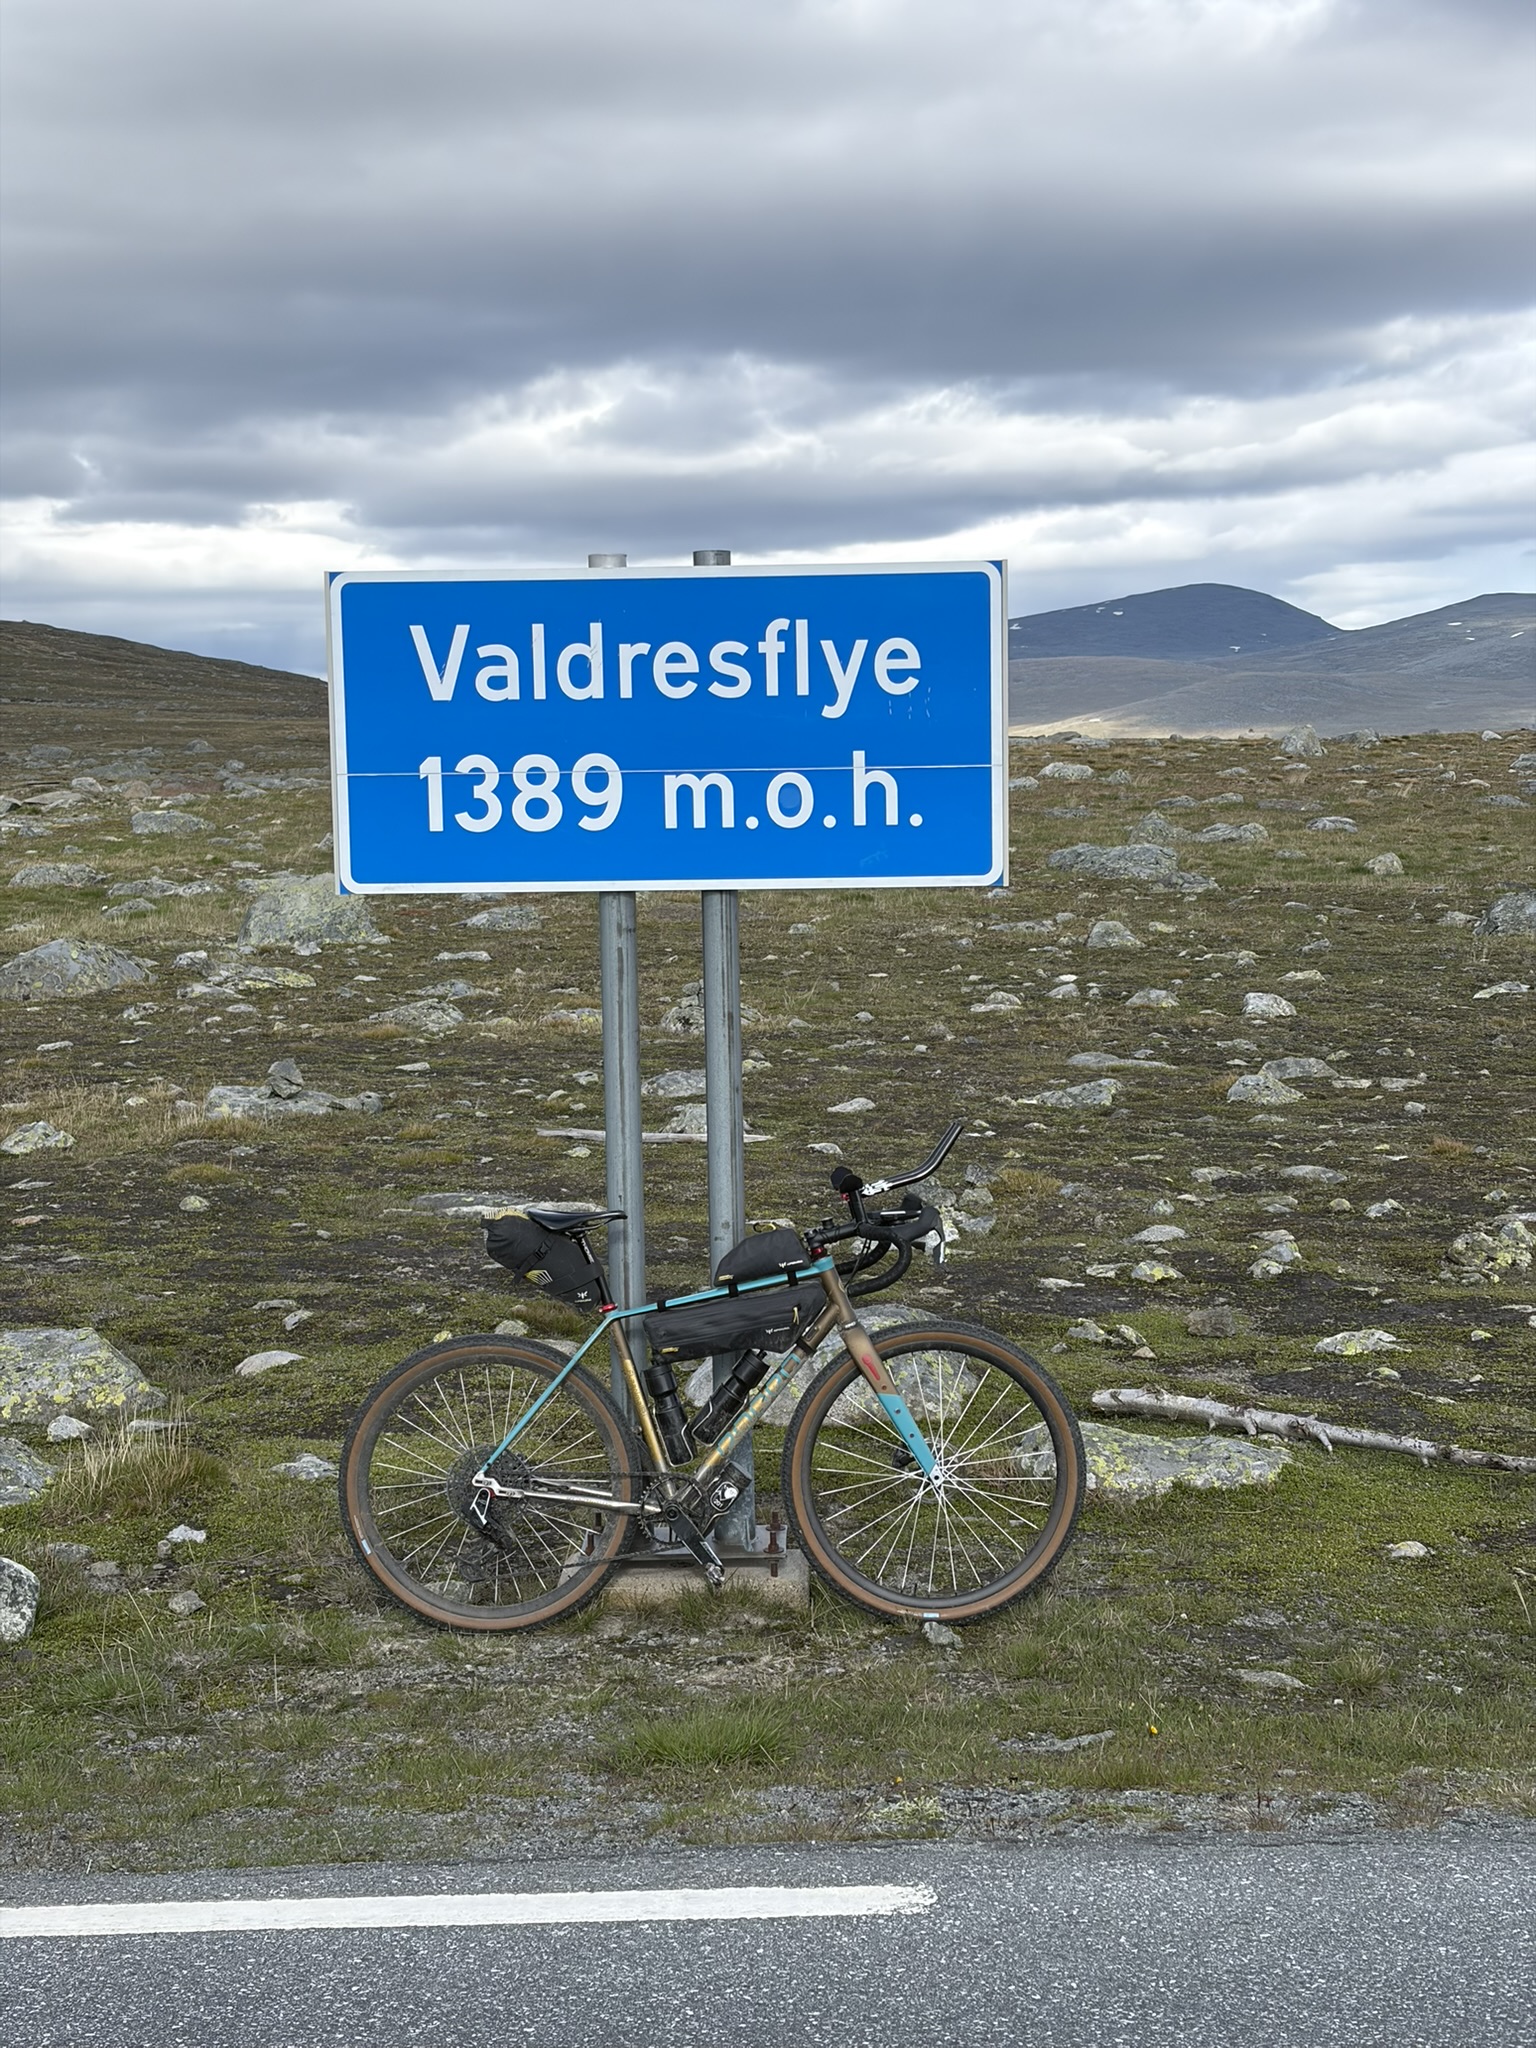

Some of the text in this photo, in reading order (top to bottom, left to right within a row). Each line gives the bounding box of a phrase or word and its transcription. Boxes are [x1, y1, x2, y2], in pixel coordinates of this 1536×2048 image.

[409, 618, 921, 719] Valdresflye
[419, 750, 924, 833] 1389 m.o.h.
